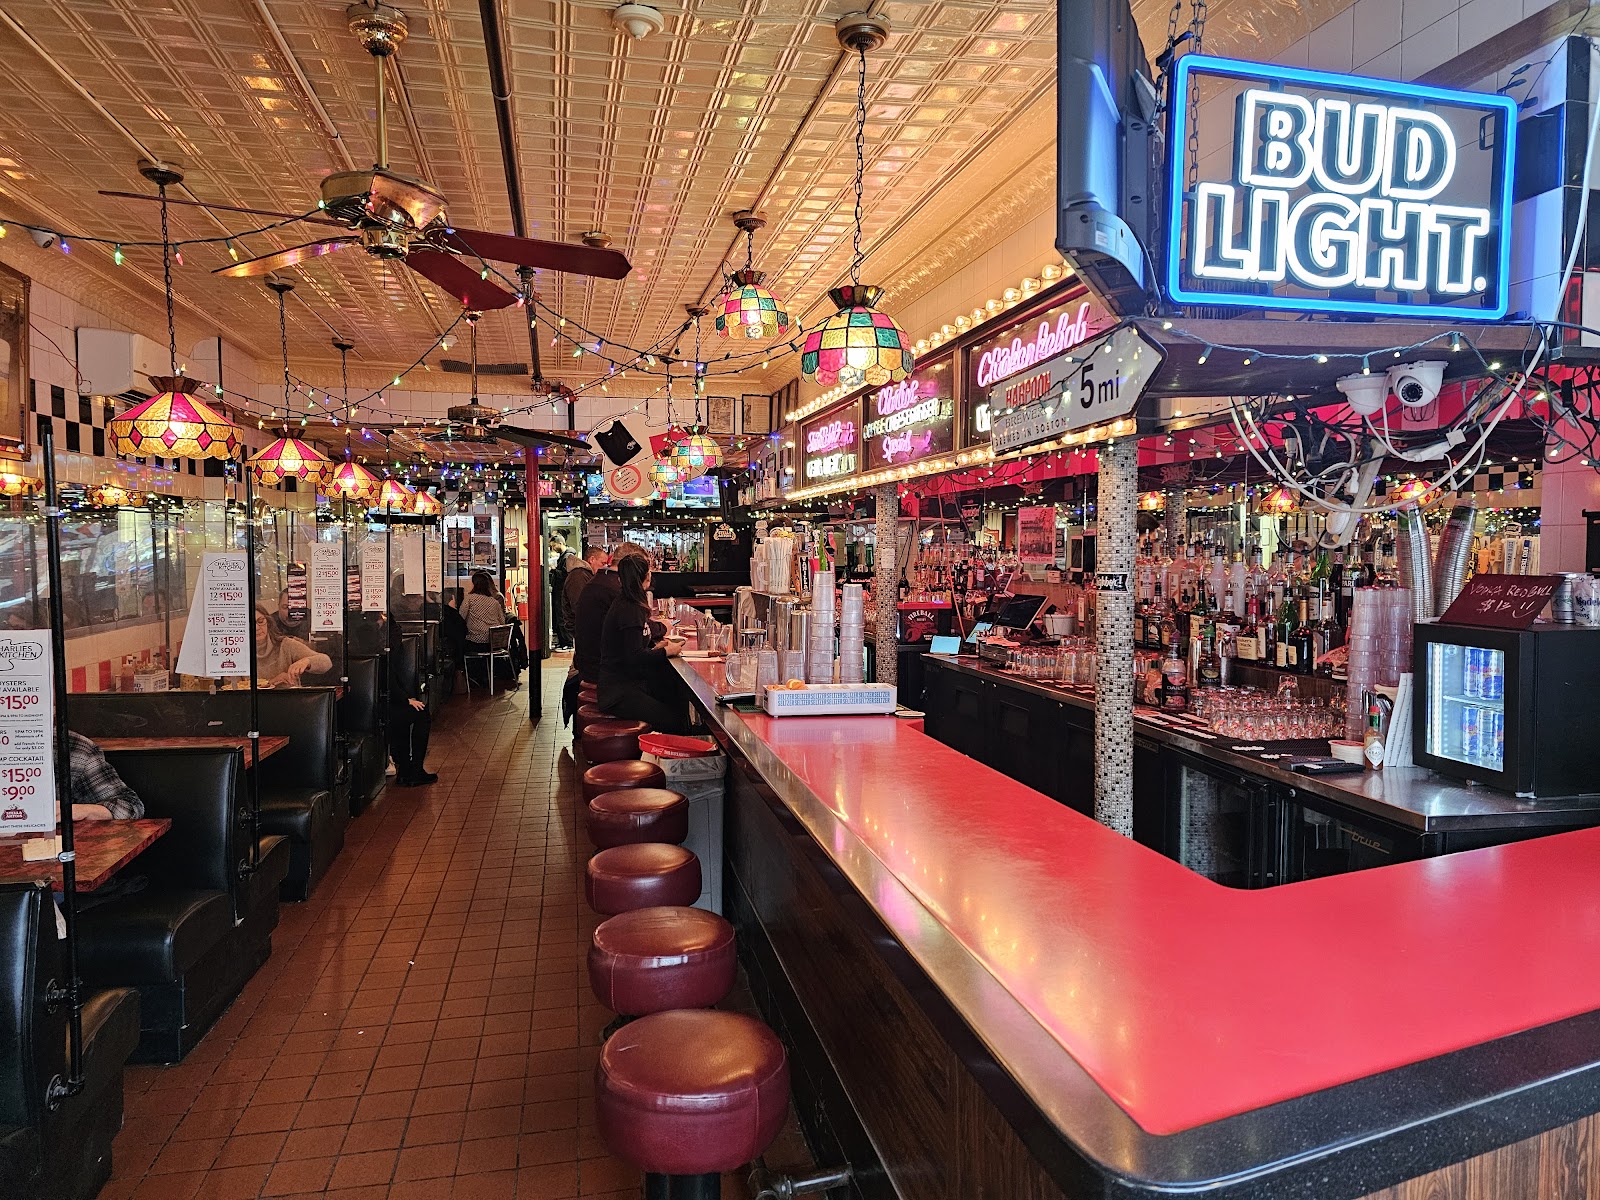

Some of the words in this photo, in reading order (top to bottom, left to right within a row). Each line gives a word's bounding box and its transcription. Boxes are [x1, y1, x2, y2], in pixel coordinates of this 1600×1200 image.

[1238, 89, 1457, 201] BUD
[1005, 371, 1051, 409] HARPOON
[1080, 363, 1094, 409] 5
[1098, 369, 1119, 404] mi
[1005, 406, 1054, 428] BREWER
[1024, 428, 1032, 438] IN
[1035, 417, 1067, 434] BOSTON
[219, 592, 243, 601] $15.00
[907, 610, 935, 621] FIREBALL
[220, 636, 244, 645] $15.00
[0, 651, 37, 659] KITCHEN
[220, 647, 241, 656] $9.00
[0, 694, 39, 710] $15.00
[2, 767, 42, 783] $15.00
[2, 785, 35, 801] $9.00
